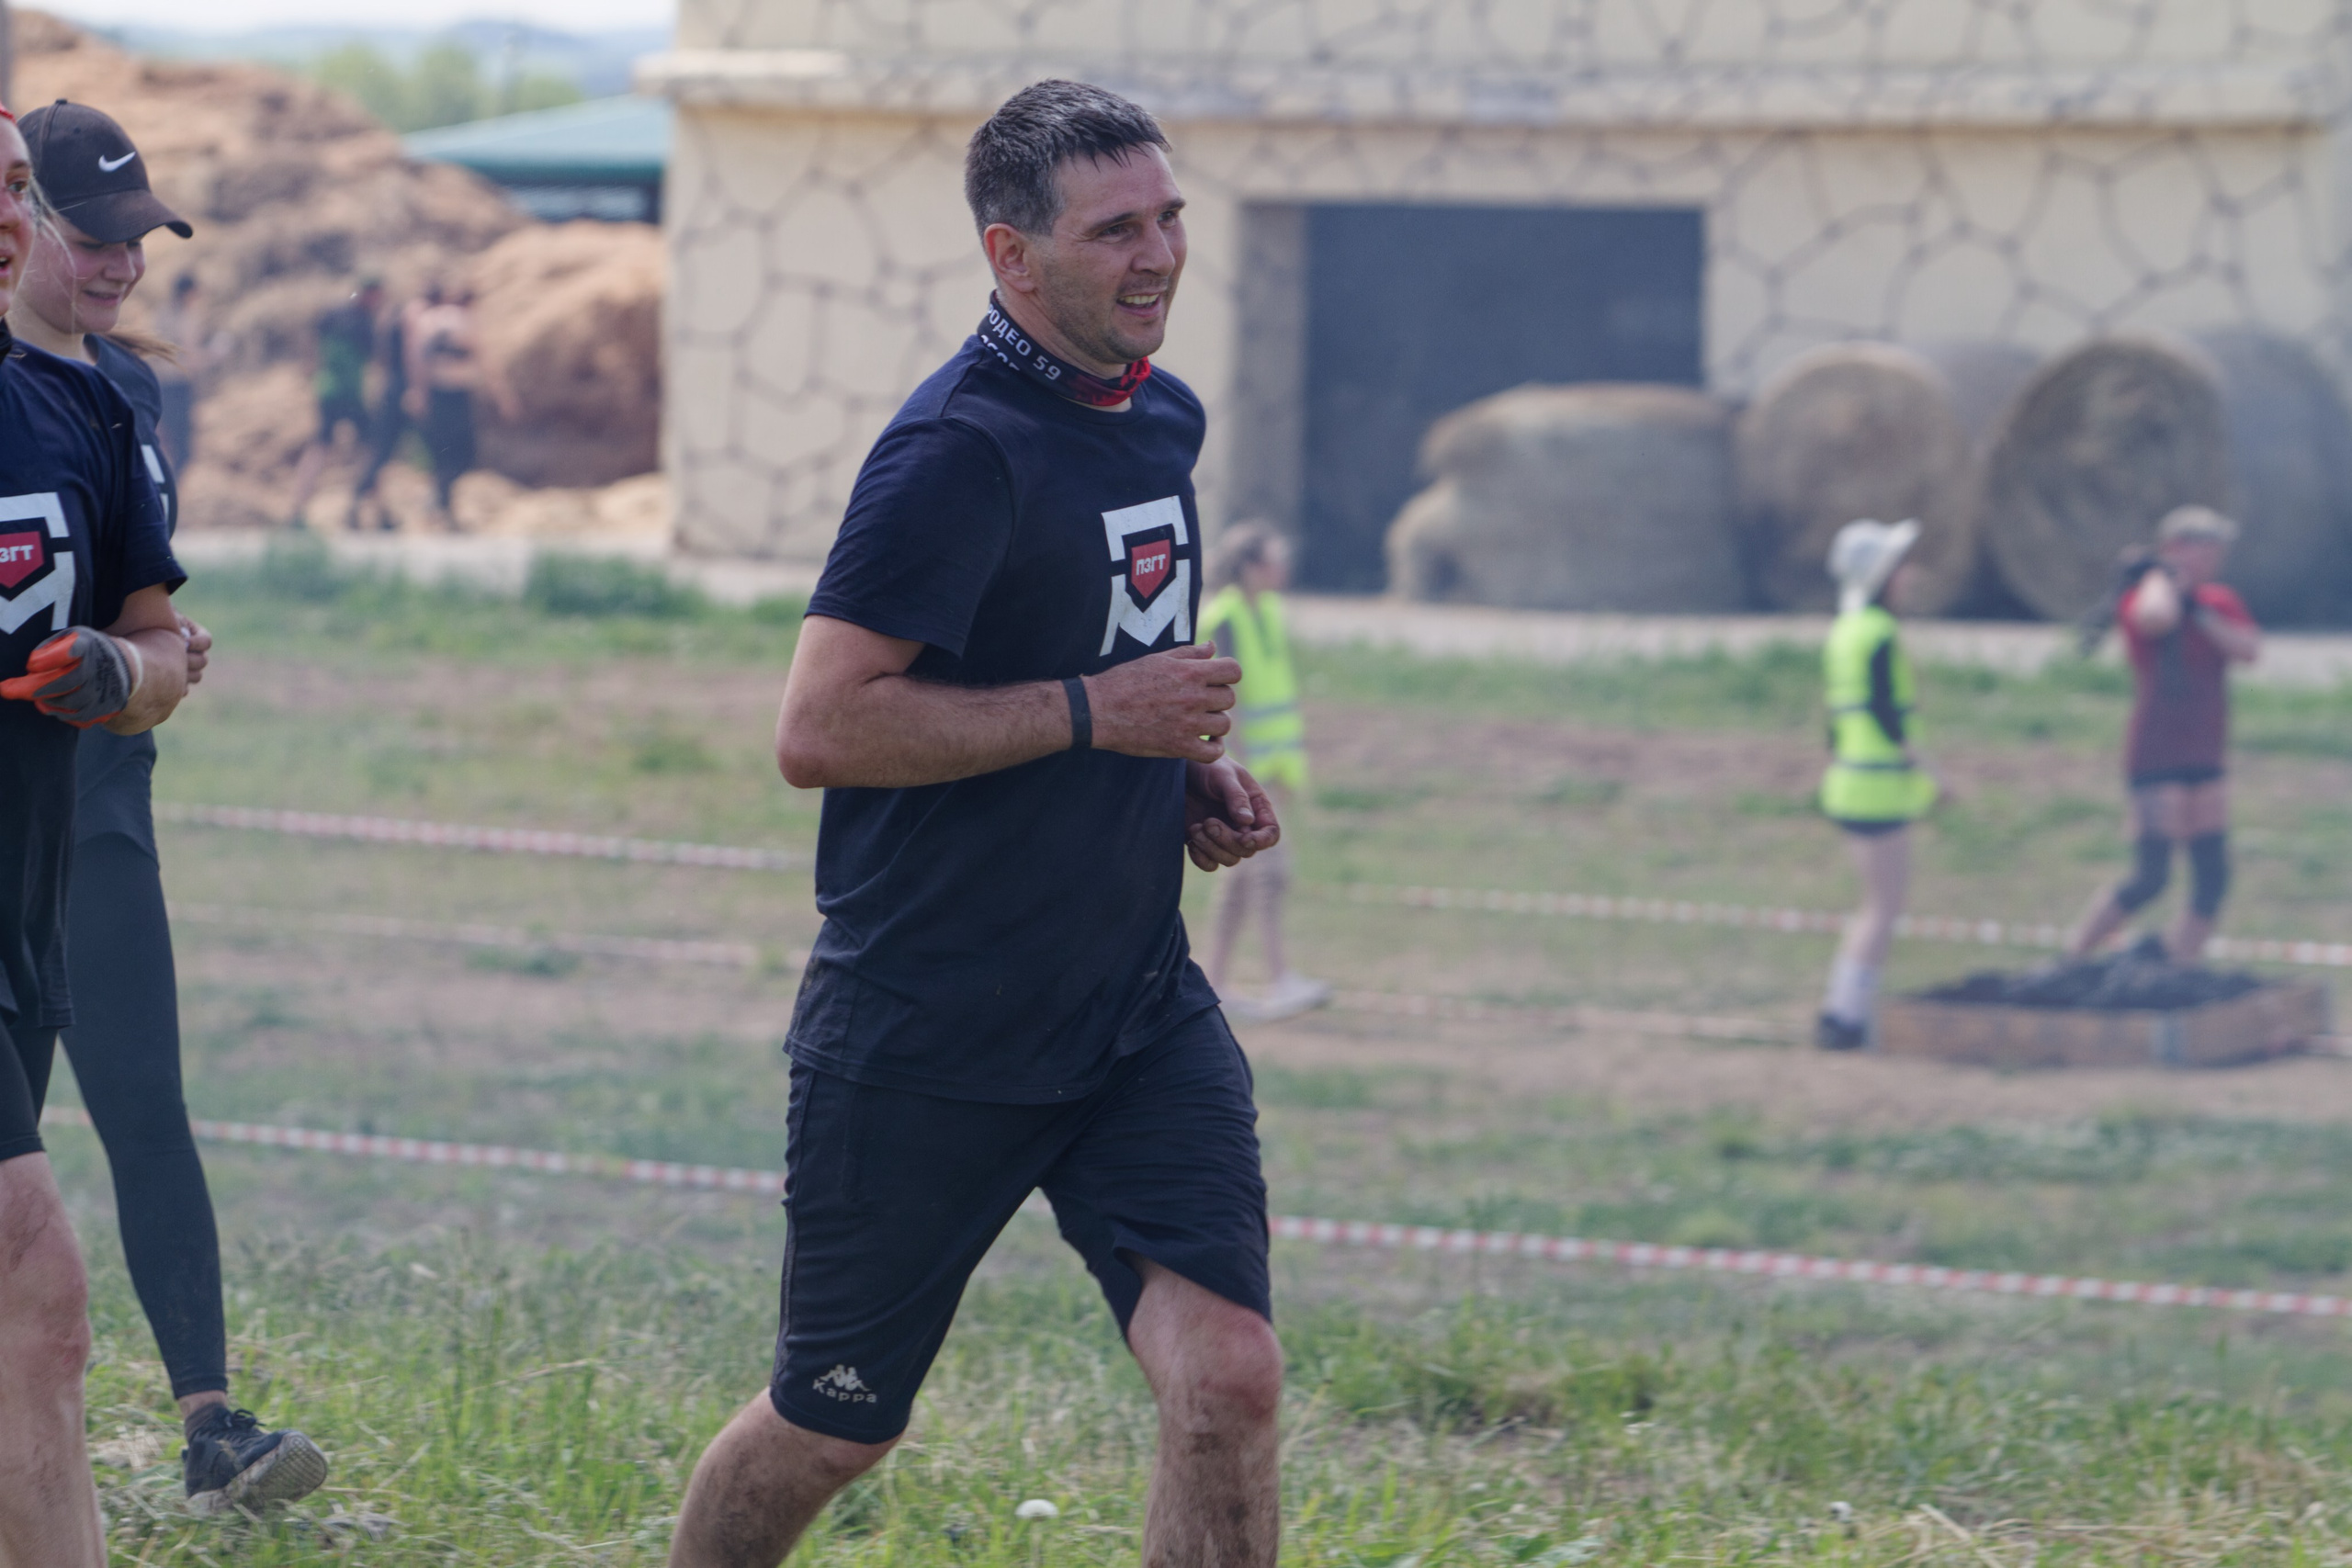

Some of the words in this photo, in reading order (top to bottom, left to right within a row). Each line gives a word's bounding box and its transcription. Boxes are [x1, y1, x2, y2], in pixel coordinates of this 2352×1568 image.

[1033, 355, 1061, 380] 59
[1136, 553, 1166, 576] ПЗГТ
[812, 1379, 877, 1404] Kappa
